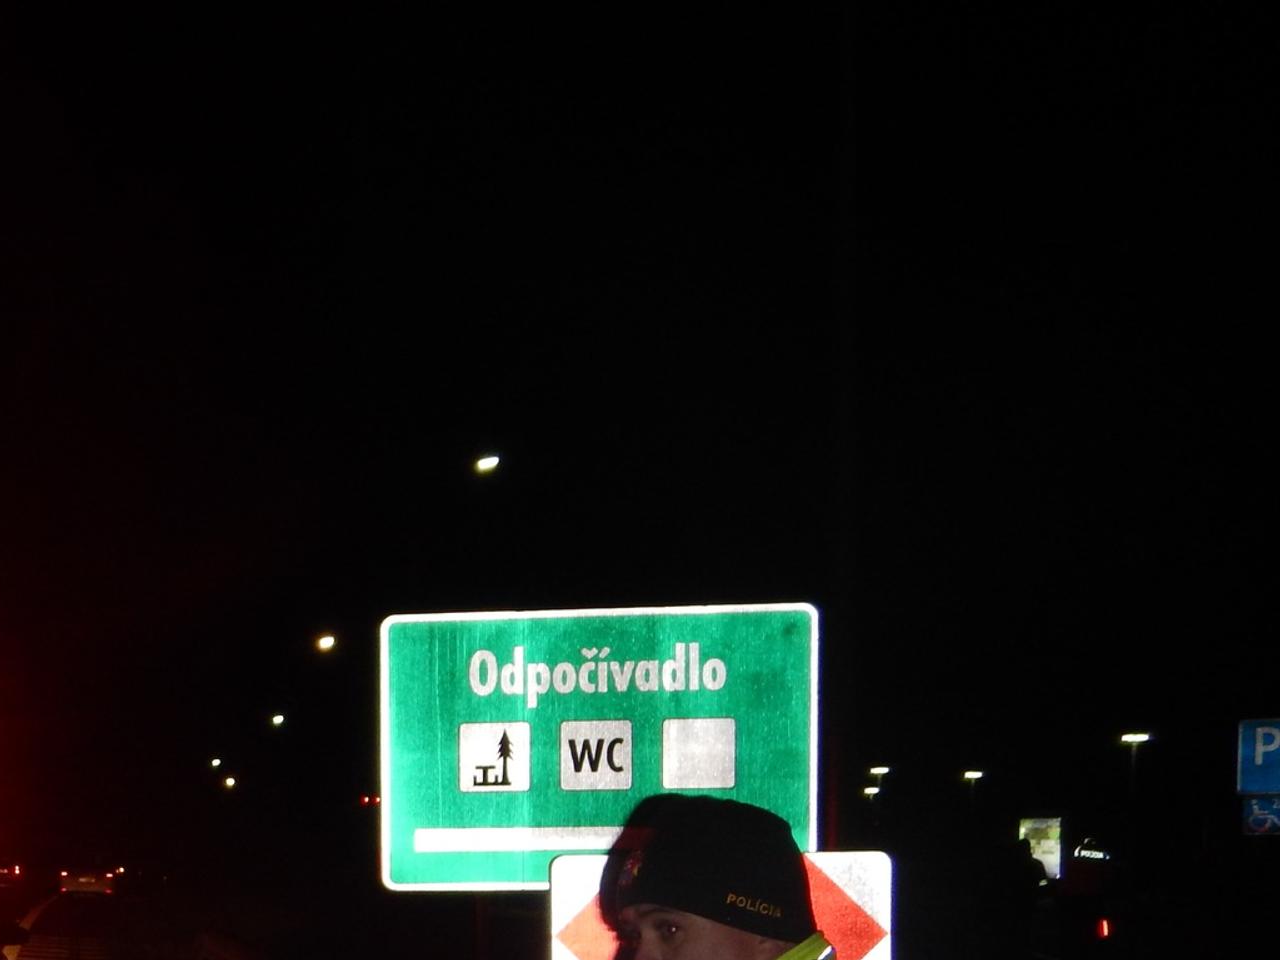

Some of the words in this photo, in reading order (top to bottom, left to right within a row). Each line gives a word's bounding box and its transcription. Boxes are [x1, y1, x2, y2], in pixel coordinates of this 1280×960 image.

[469, 642, 726, 710] Odpočívadlo
[568, 737, 624, 773] WC
[1254, 726, 1280, 766] P
[726, 892, 782, 917] POLÍCIA
